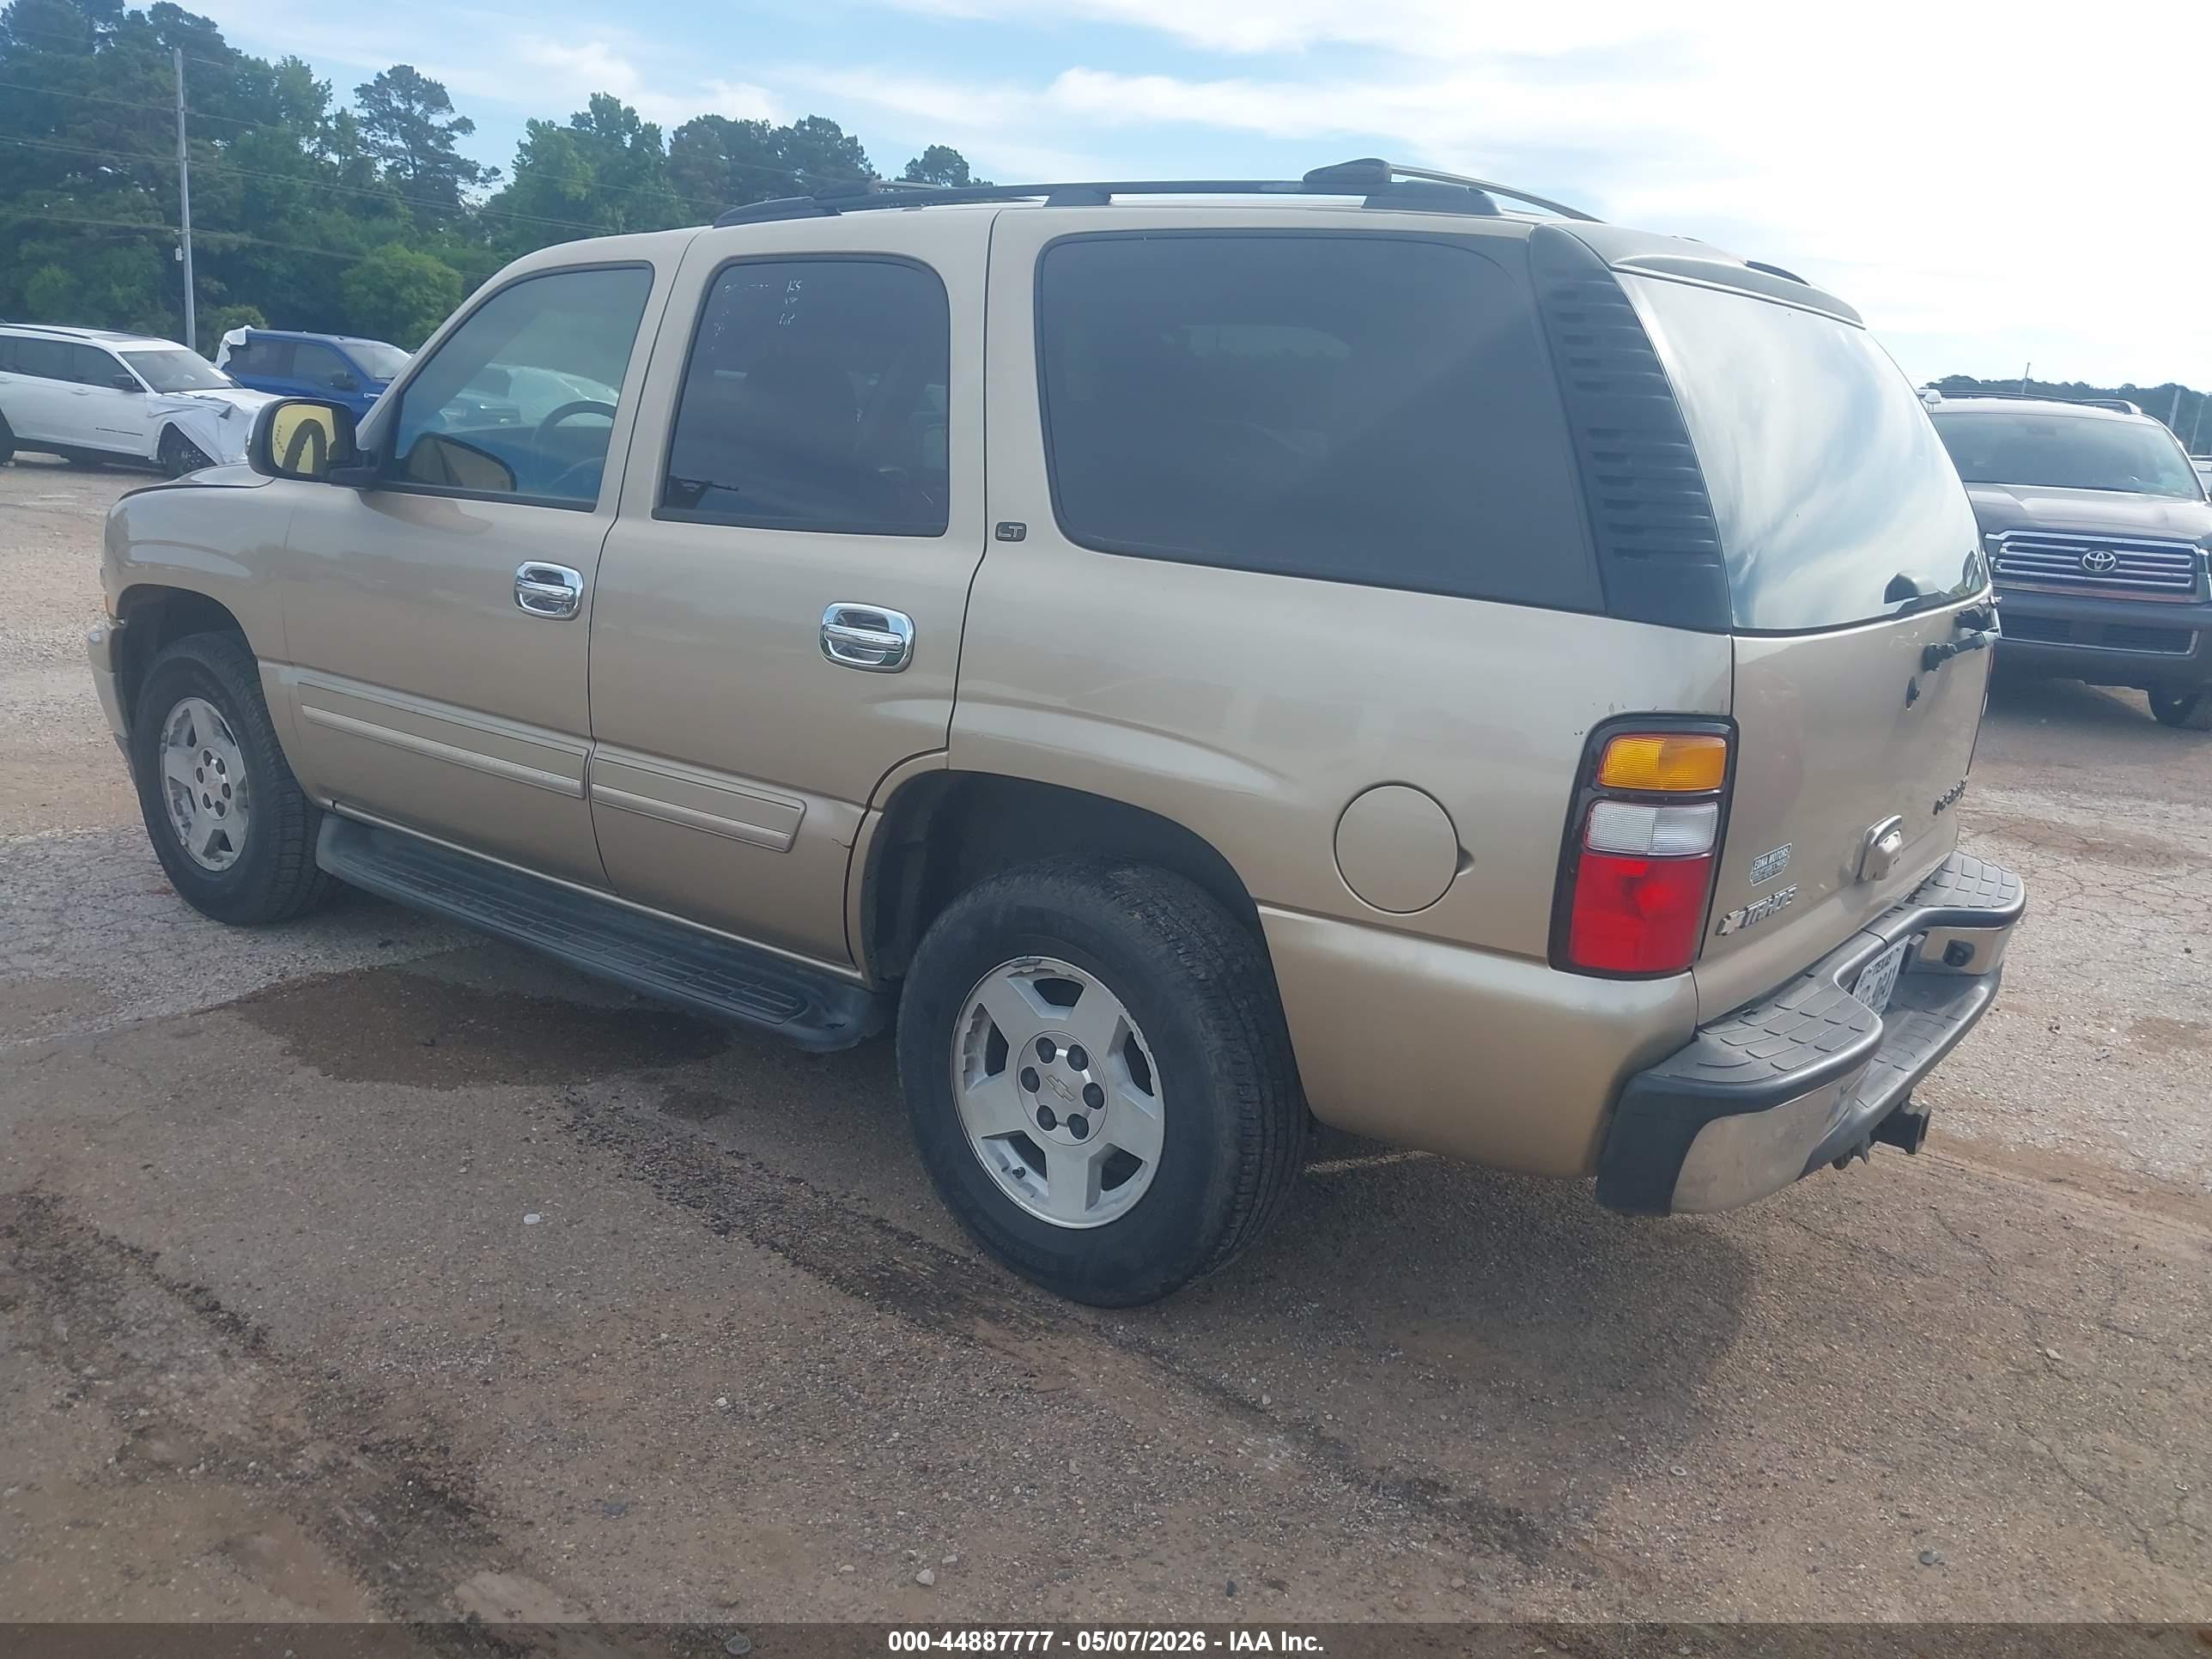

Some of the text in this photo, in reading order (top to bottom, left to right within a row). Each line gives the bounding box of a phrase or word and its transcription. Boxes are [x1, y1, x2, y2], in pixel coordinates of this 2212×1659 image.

[997, 525, 1024, 538] LT
[1768, 846, 1790, 864] MOTORS
[1743, 884, 1797, 927] TAHOE
